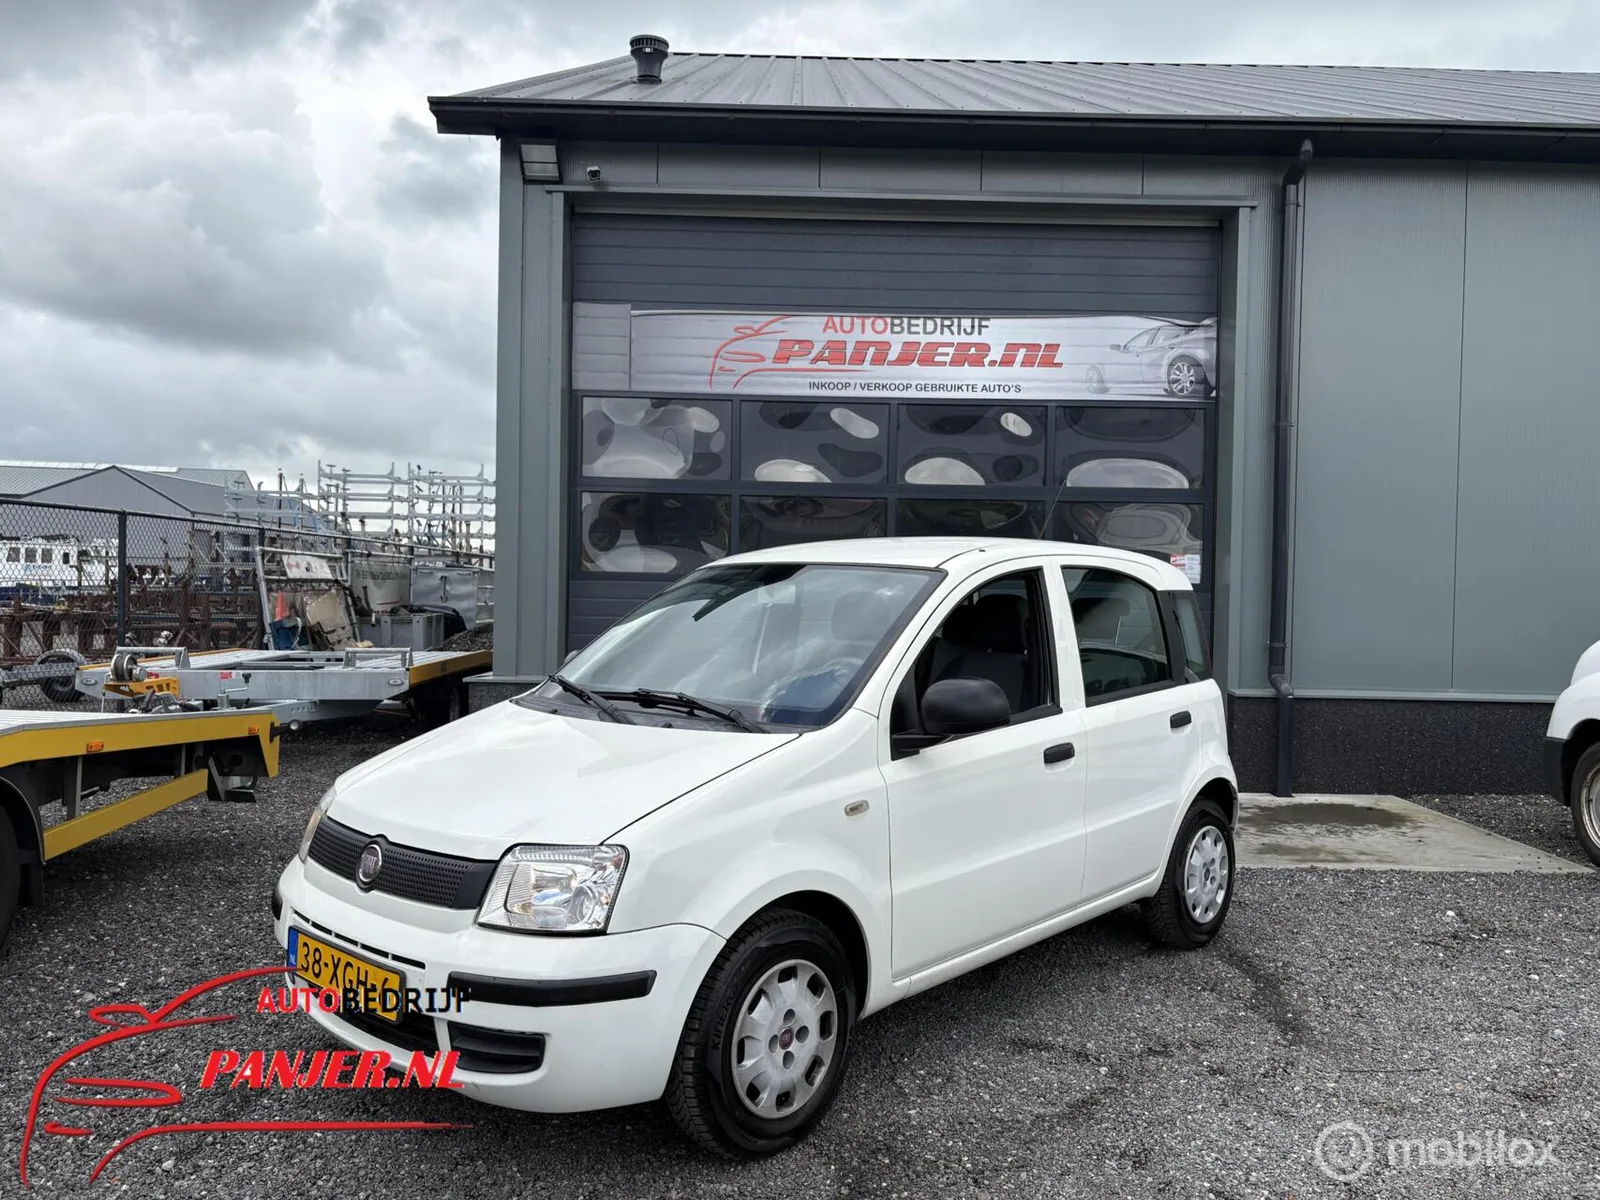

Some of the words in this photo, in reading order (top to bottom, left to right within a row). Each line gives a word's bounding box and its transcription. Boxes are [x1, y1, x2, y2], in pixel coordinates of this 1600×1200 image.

[822, 315, 991, 336] AUTOBEDRIJF
[772, 339, 1063, 368] PANJER.NL
[809, 381, 850, 391] INKOOP
[860, 382, 912, 392] VERKOOP
[915, 383, 978, 393] GEBRUIKTE
[981, 384, 1022, 393] AUTO'S
